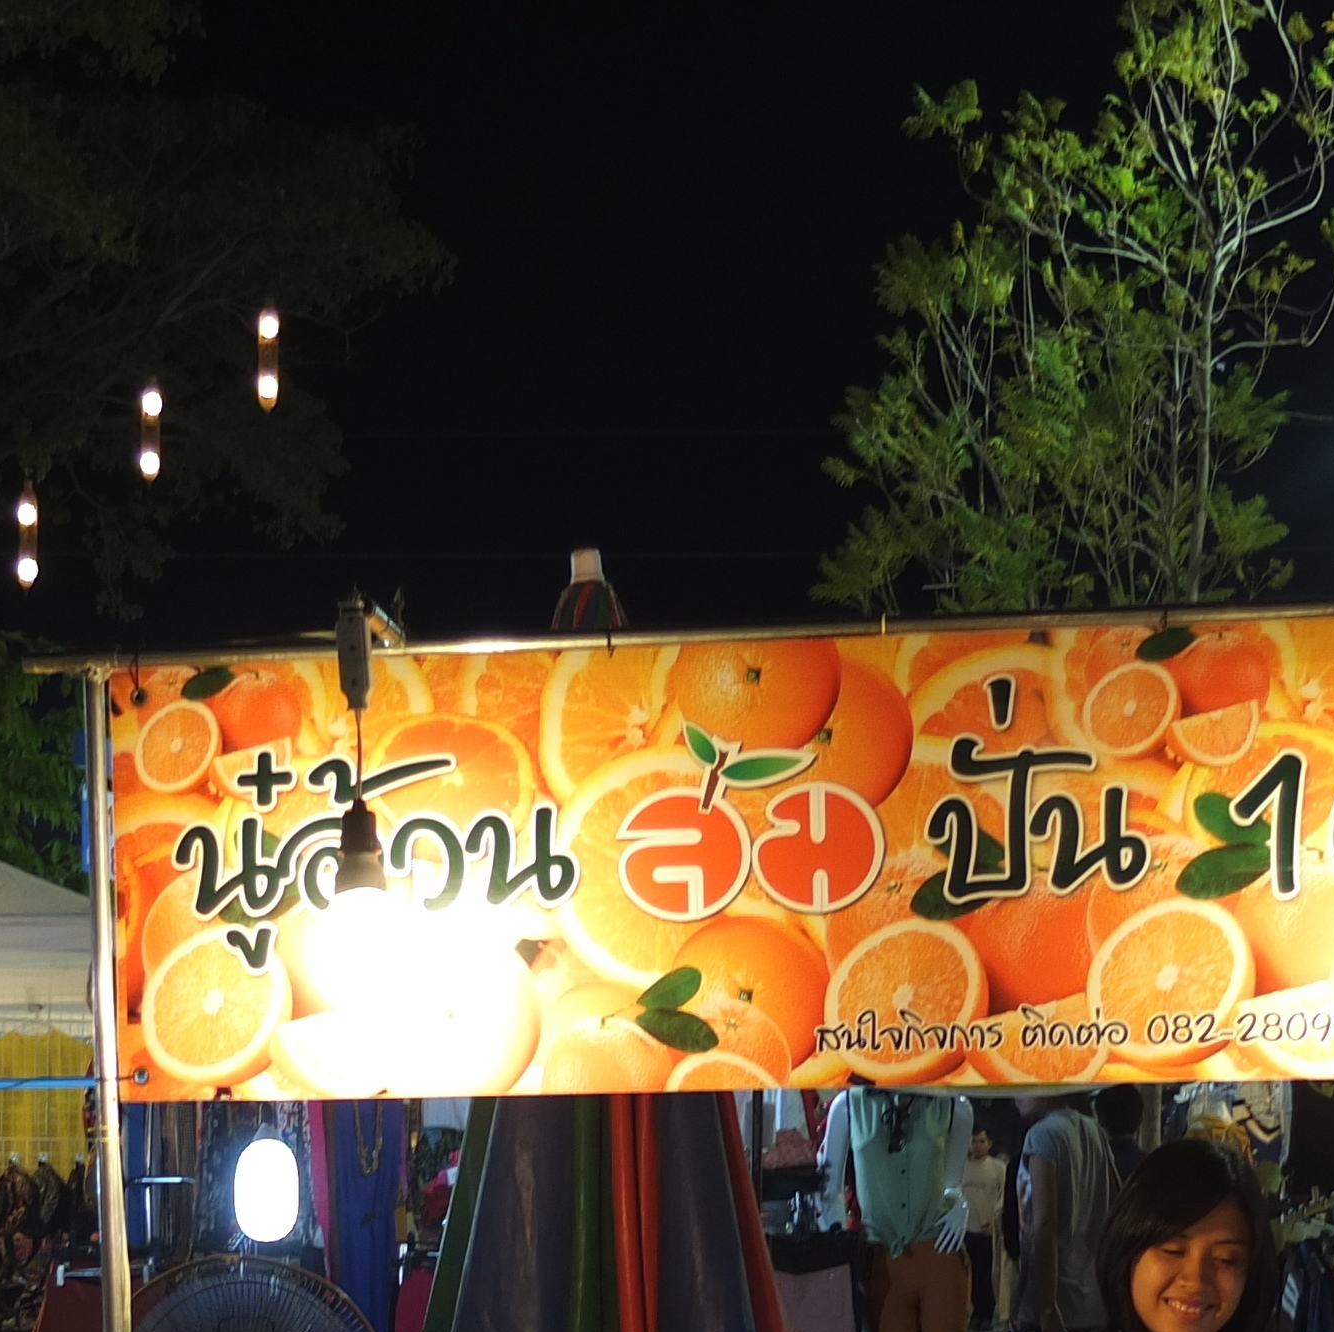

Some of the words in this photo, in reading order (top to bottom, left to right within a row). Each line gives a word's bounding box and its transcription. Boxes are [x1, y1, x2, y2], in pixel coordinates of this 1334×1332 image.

[926, 676, 1149, 906] ปั่น
[815, 1005, 1004, 1054] สนใจกิจการ
[1020, 1003, 1130, 1048] ติดต่อ
